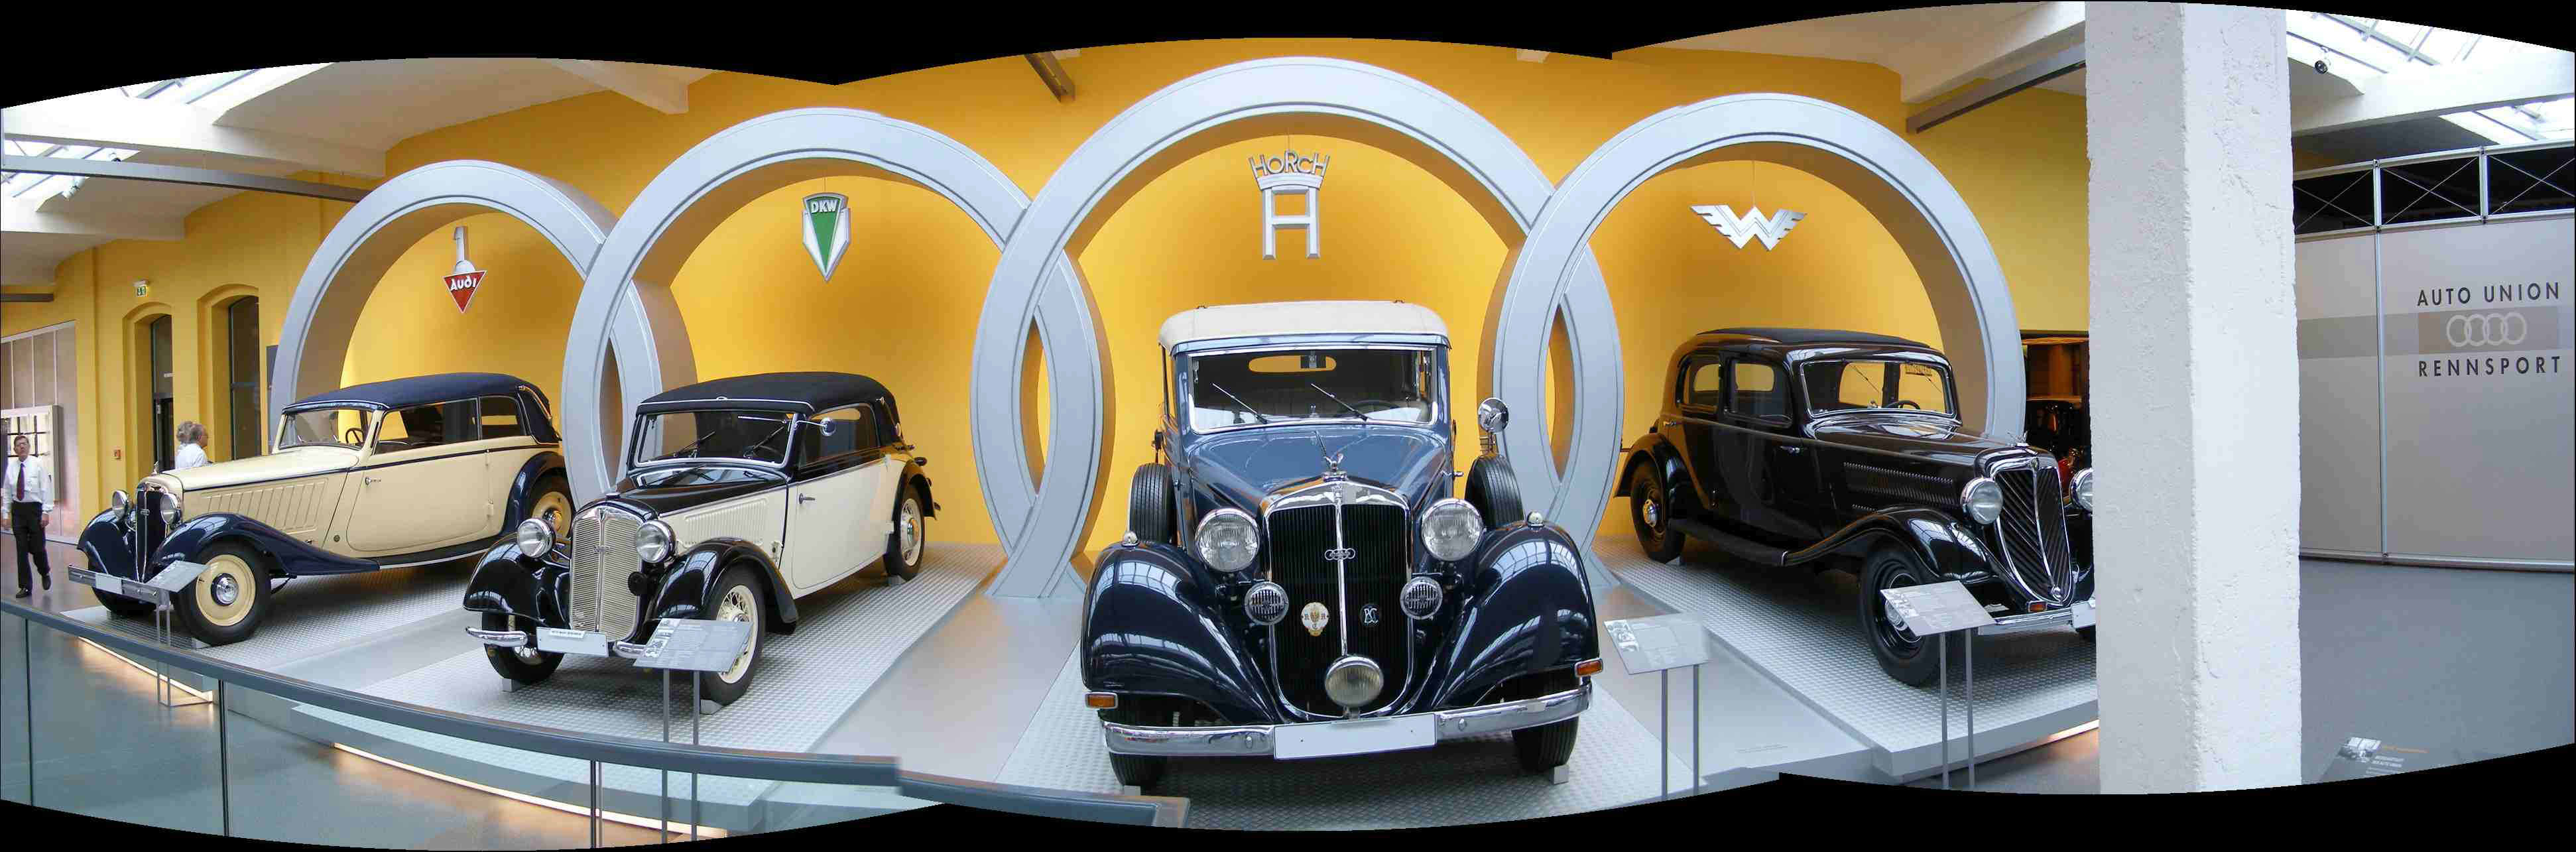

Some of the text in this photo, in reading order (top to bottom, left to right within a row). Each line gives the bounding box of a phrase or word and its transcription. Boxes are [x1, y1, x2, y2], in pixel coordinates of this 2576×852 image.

[810, 200, 838, 213] DKW
[2417, 282, 2559, 306] AUTO UNION
[2419, 356, 2560, 377] RENNSPORT
